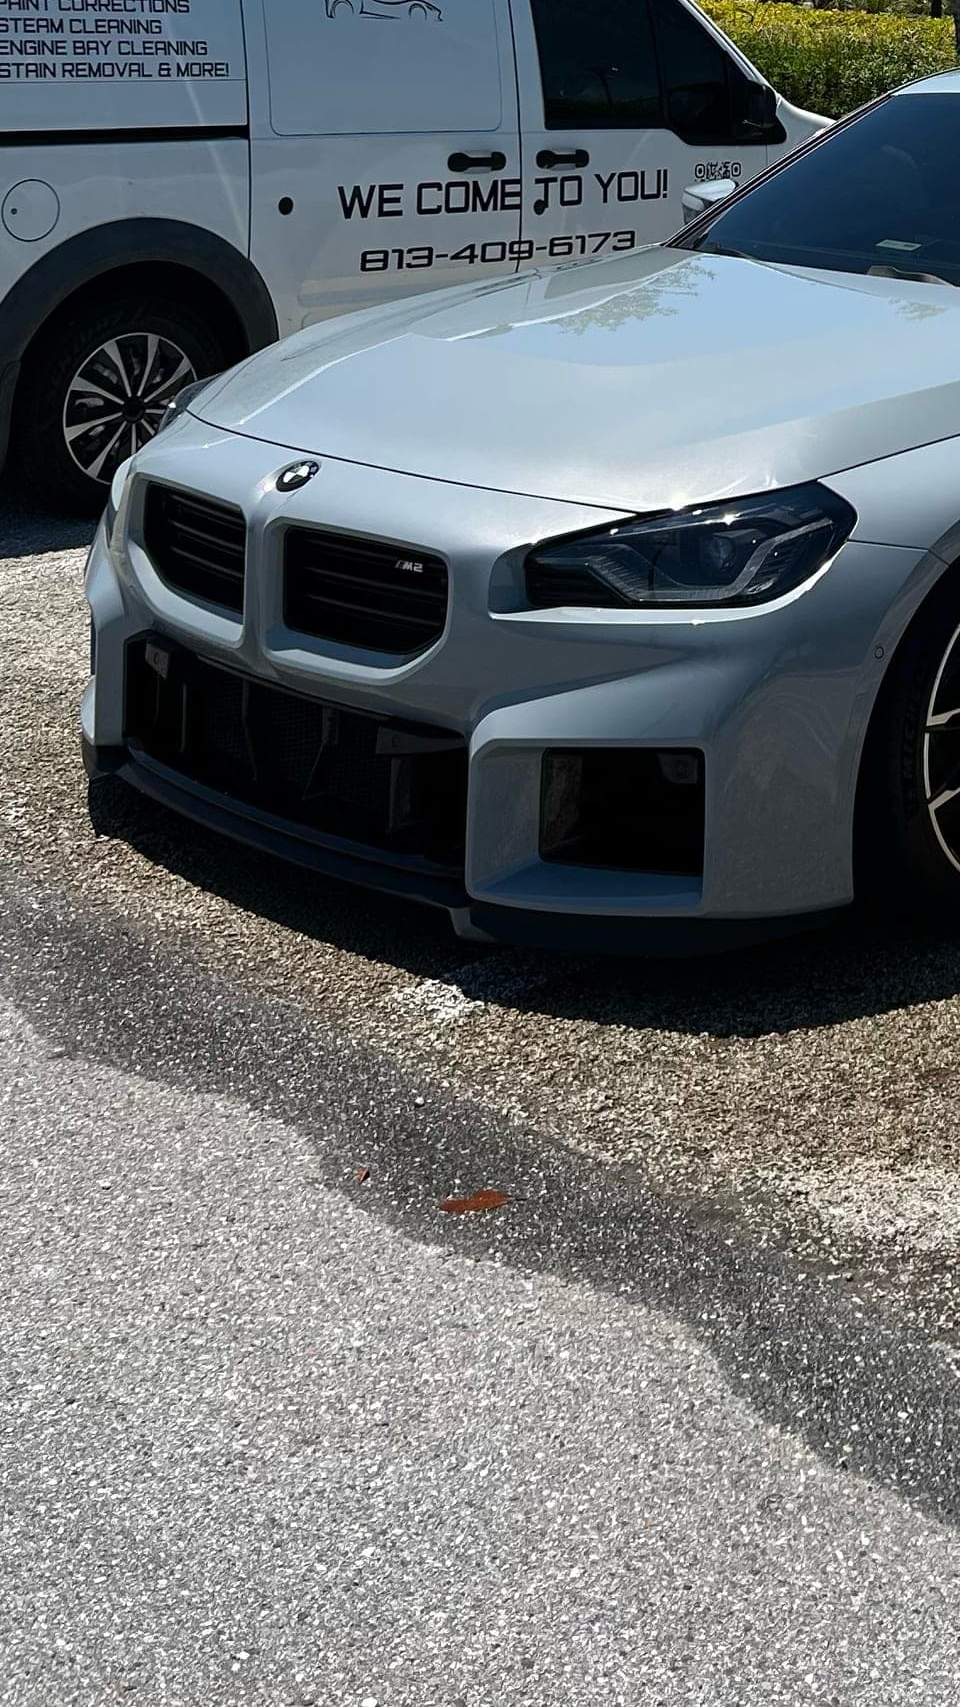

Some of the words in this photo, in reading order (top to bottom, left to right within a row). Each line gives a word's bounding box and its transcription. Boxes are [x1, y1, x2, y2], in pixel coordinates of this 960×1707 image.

[0, 17, 64, 33] STEAM
[69, 18, 162, 34] CLEANING
[0, 39, 67, 56] ENGINE
[72, 40, 112, 56] BAY
[118, 40, 208, 56] CLEANING
[0, 62, 56, 78] STAIN
[61, 62, 152, 78] REMOVAL
[158, 63, 171, 78] &
[176, 62, 229, 78] MORE!
[338, 184, 404, 219] WE
[416, 178, 522, 216] COME
[534, 175, 583, 208] TO
[594, 169, 668, 204] YOU!
[360, 230, 636, 272] 813-409-6173
